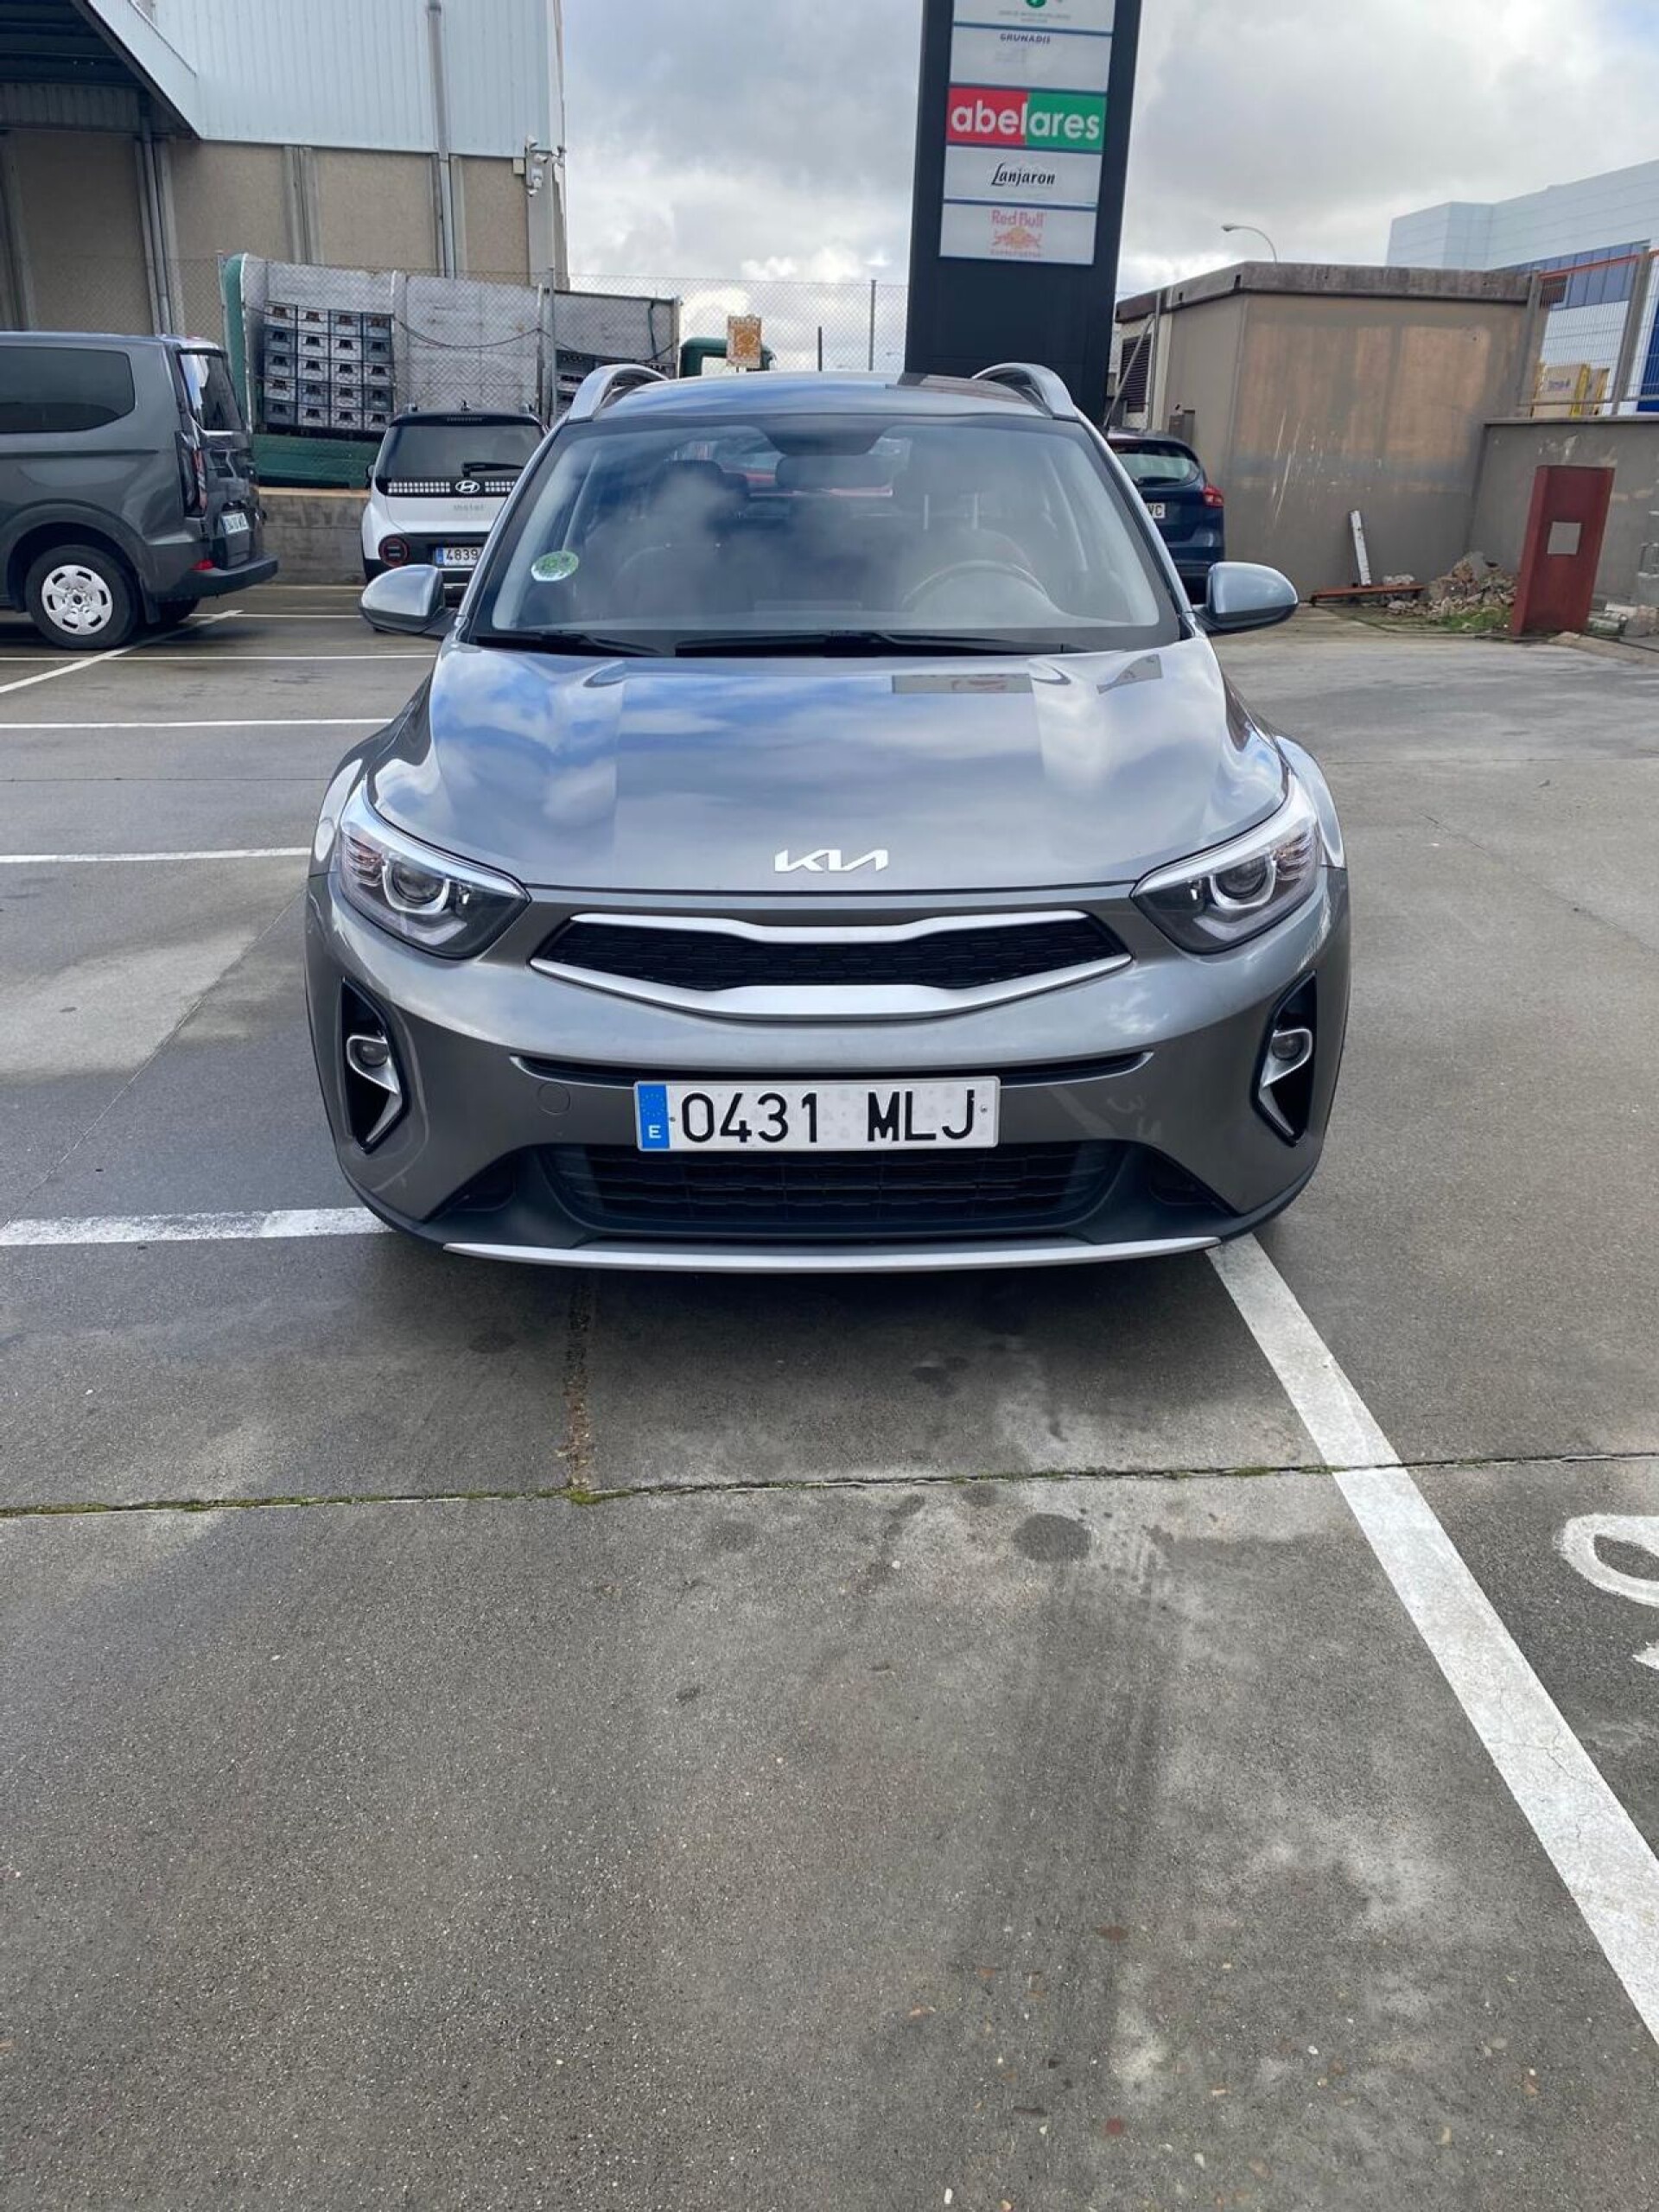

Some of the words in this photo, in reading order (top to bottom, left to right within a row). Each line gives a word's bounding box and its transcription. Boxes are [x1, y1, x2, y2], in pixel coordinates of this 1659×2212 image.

[950, 99, 1100, 140] abelares
[774, 849, 888, 872] KIA
[648, 1125, 662, 1139] E
[681, 1091, 818, 1143] 0431
[867, 1089, 975, 1141] MLJ
